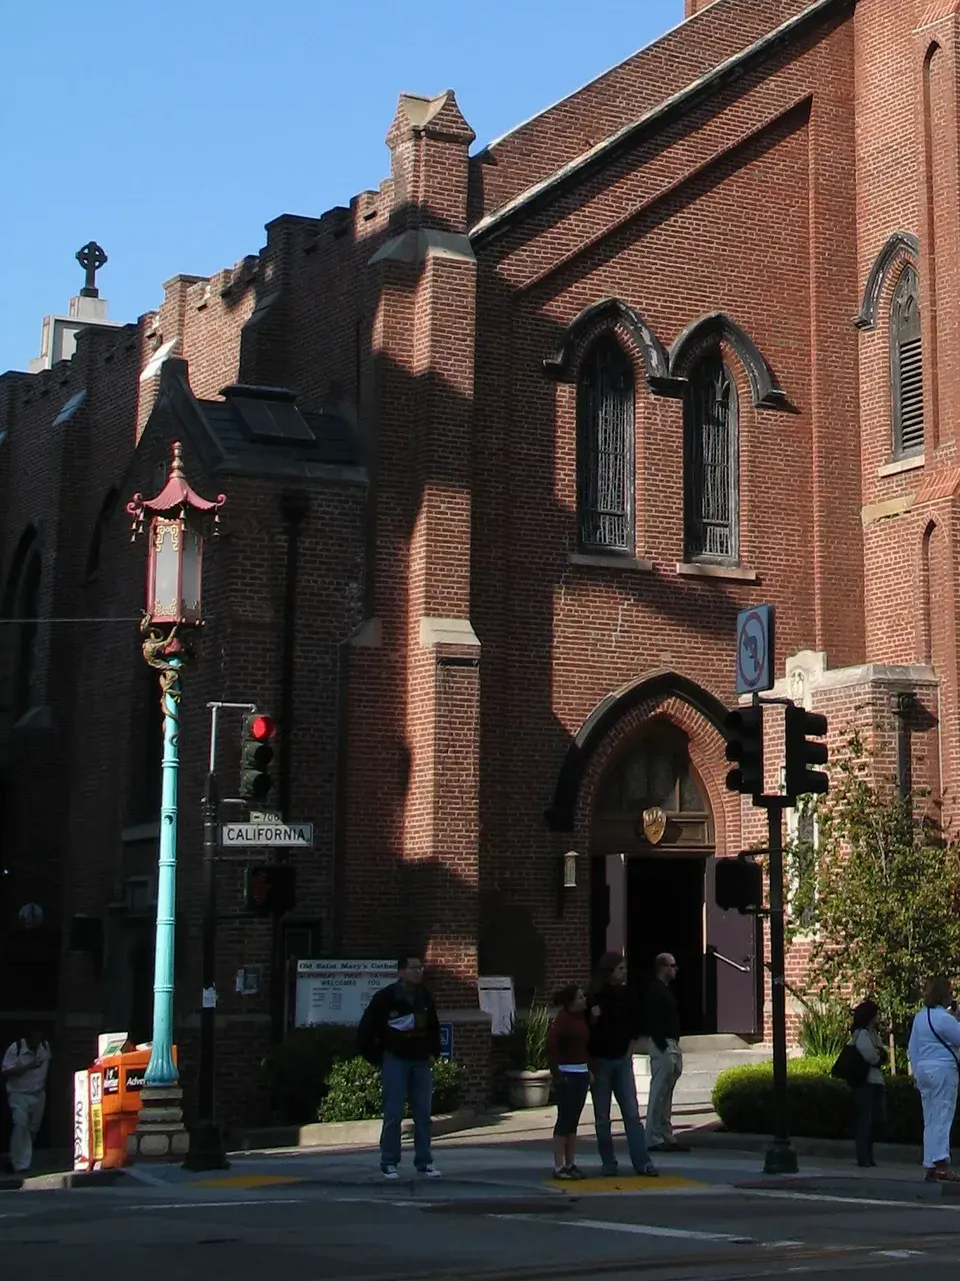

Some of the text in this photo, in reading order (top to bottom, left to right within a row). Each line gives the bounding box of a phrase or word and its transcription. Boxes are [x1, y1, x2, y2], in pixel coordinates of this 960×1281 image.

[227, 828, 305, 841] CALIFORNIA
[299, 962, 398, 971] Old Saint Mary's Cathed
